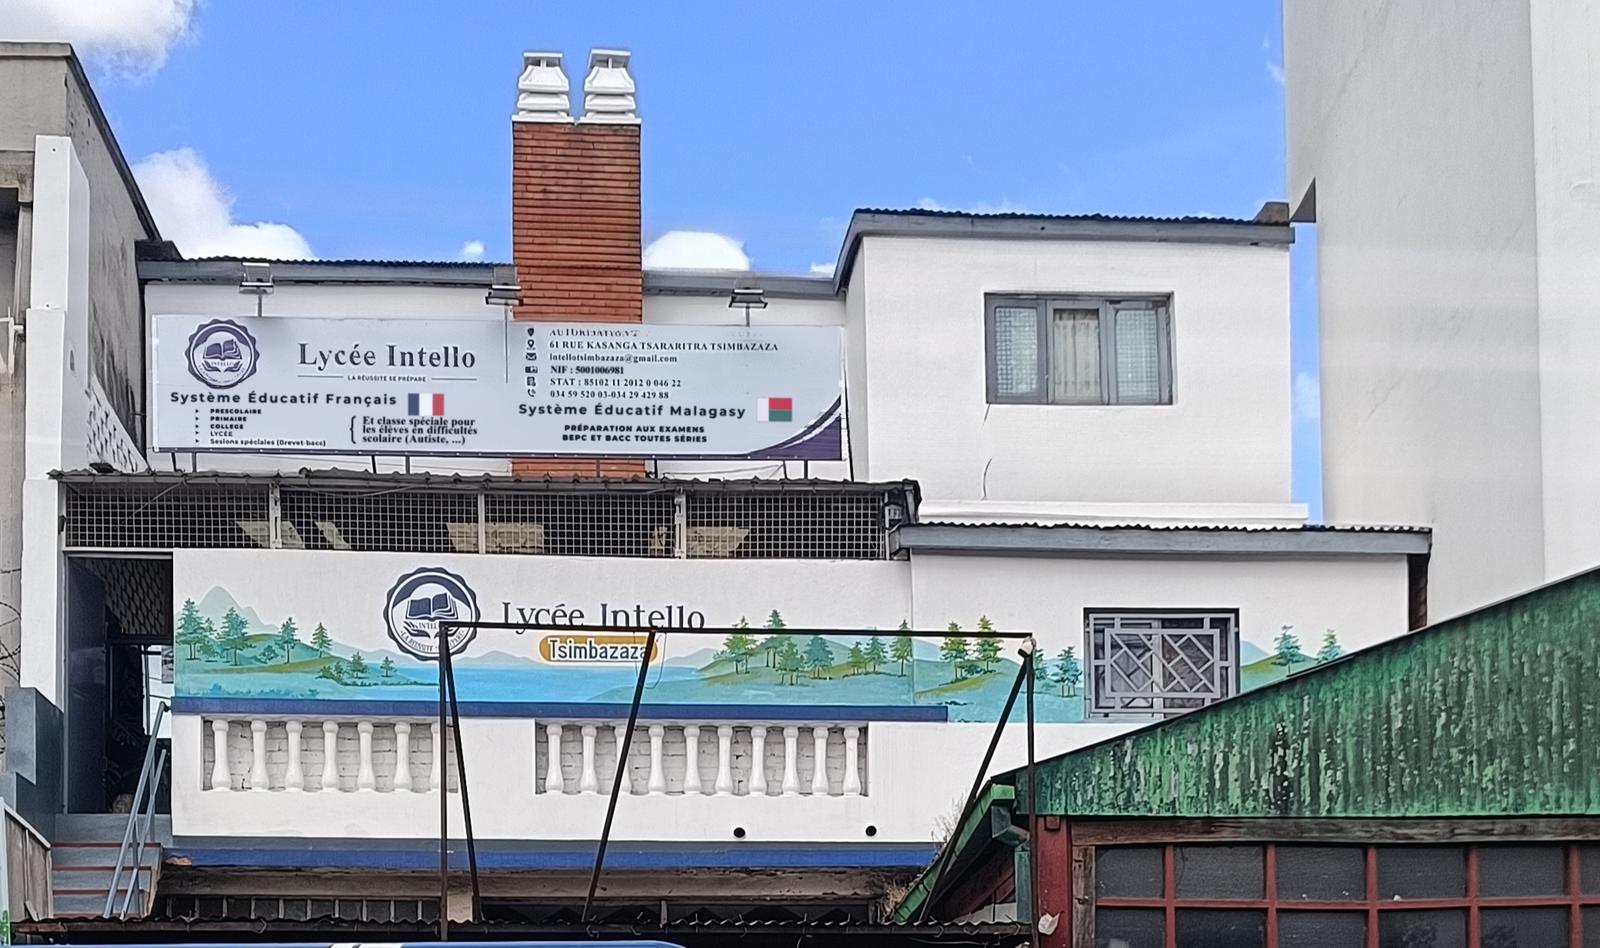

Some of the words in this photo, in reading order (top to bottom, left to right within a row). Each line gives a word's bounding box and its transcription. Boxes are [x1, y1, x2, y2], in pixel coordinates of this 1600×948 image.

[587, 341, 637, 350] KASANGA
[640, 342, 708, 350] TSARARITRA
[711, 343, 778, 351] TSIMBAZAZA
[298, 343, 376, 371] Lycée
[386, 345, 475, 368] Intello
[550, 353, 677, 364] intellotsimbazaza@gmail.com
[550, 366, 568, 374] NIF
[170, 392, 241, 405] Système
[248, 390, 319, 404] Éducatif
[326, 393, 397, 408] Français
[519, 404, 587, 416] Système
[594, 403, 664, 416] Éducatif
[670, 405, 746, 418] Malagasy
[363, 416, 375, 425] Et
[377, 417, 406, 425] classe
[409, 417, 448, 427] spéciale
[451, 419, 475, 427] pour
[363, 425, 376, 433] les
[379, 425, 409, 434] élèves
[427, 426, 478, 434] difficultés
[564, 424, 632, 432] PRÉPARATION
[362, 434, 402, 443] scolaire
[674, 434, 708, 443] SÉRIES
[502, 602, 585, 634] Lycée
[600, 603, 705, 629] Intello
[550, 640, 648, 660] Tsimbazaza
